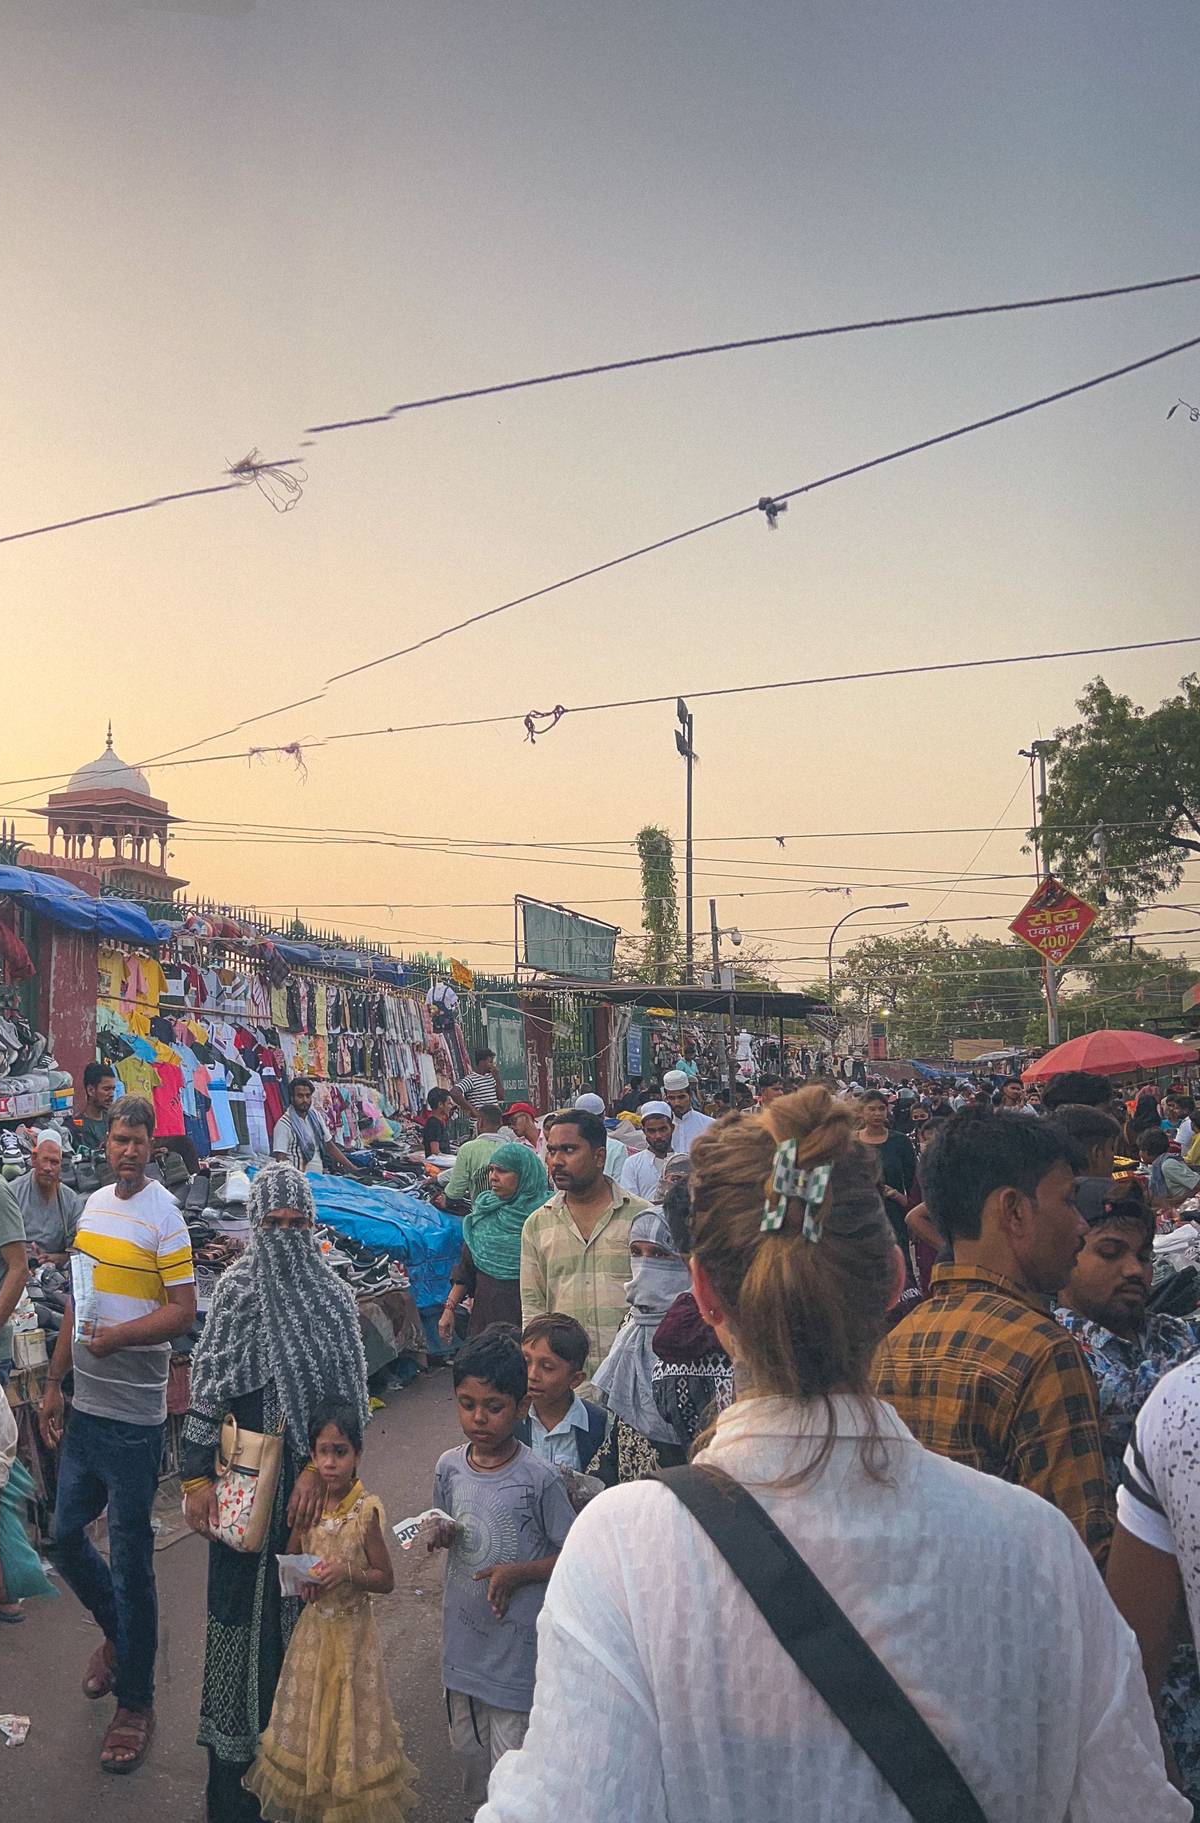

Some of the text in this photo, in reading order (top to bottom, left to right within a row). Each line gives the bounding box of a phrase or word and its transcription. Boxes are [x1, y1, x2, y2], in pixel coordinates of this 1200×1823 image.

[1026, 909, 1080, 926] सेल
[1028, 922, 1080, 937] एक दाम
[1039, 934, 1075, 948] 400/-
